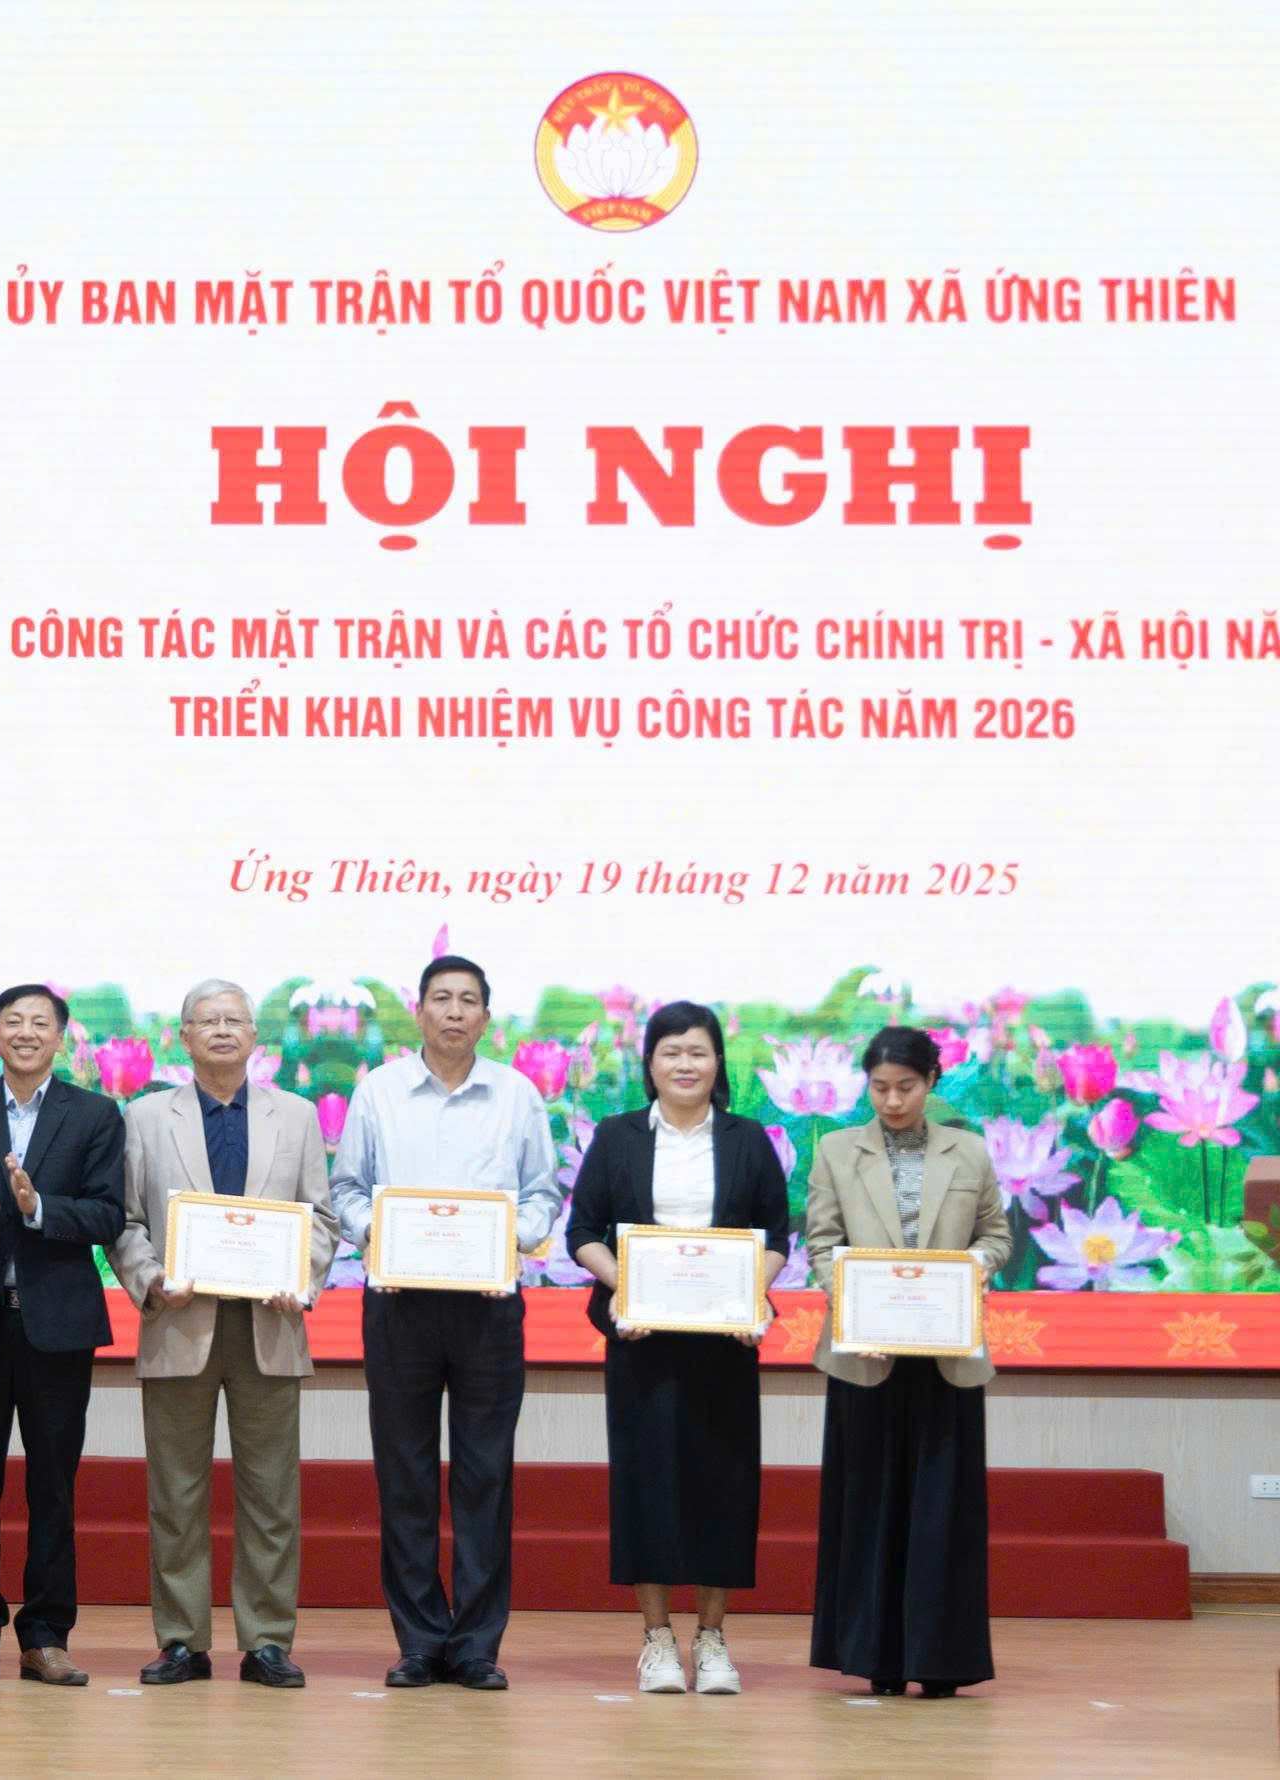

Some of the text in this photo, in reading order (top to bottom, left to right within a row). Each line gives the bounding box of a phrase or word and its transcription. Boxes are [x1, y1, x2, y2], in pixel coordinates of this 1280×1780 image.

[7, 260, 1236, 336] ỦY BAN MẶT TRẬN TỔ QUỐC VIỆT NAM XÃ ỨNG THIÊN
[210, 400, 1033, 552] HỘI NGHỊ
[11, 608, 123, 659] CÔNG
[138, 608, 215, 659] TÁC
[231, 609, 320, 669] MẶT
[333, 609, 442, 669] TRẬN
[457, 609, 510, 659] VÀ
[525, 609, 607, 660] CÁC
[623, 602, 673, 660] TỔ
[688, 610, 799, 660] CHỨC
[816, 610, 944, 660] CHÍNH
[959, 618, 1023, 669] TRỊ
[1040, 638, 1053, 647] -
[1070, 611, 1125, 660] XÃ
[1141, 610, 1209, 670] HỘI
[169, 679, 1076, 748] TRIỂN KHAI NHIỆM VỤ CÔNG TÁC NĂM 2026
[229, 848, 1019, 904] Ứng Thiên, ngày 19 tháng 12 năm 2025
